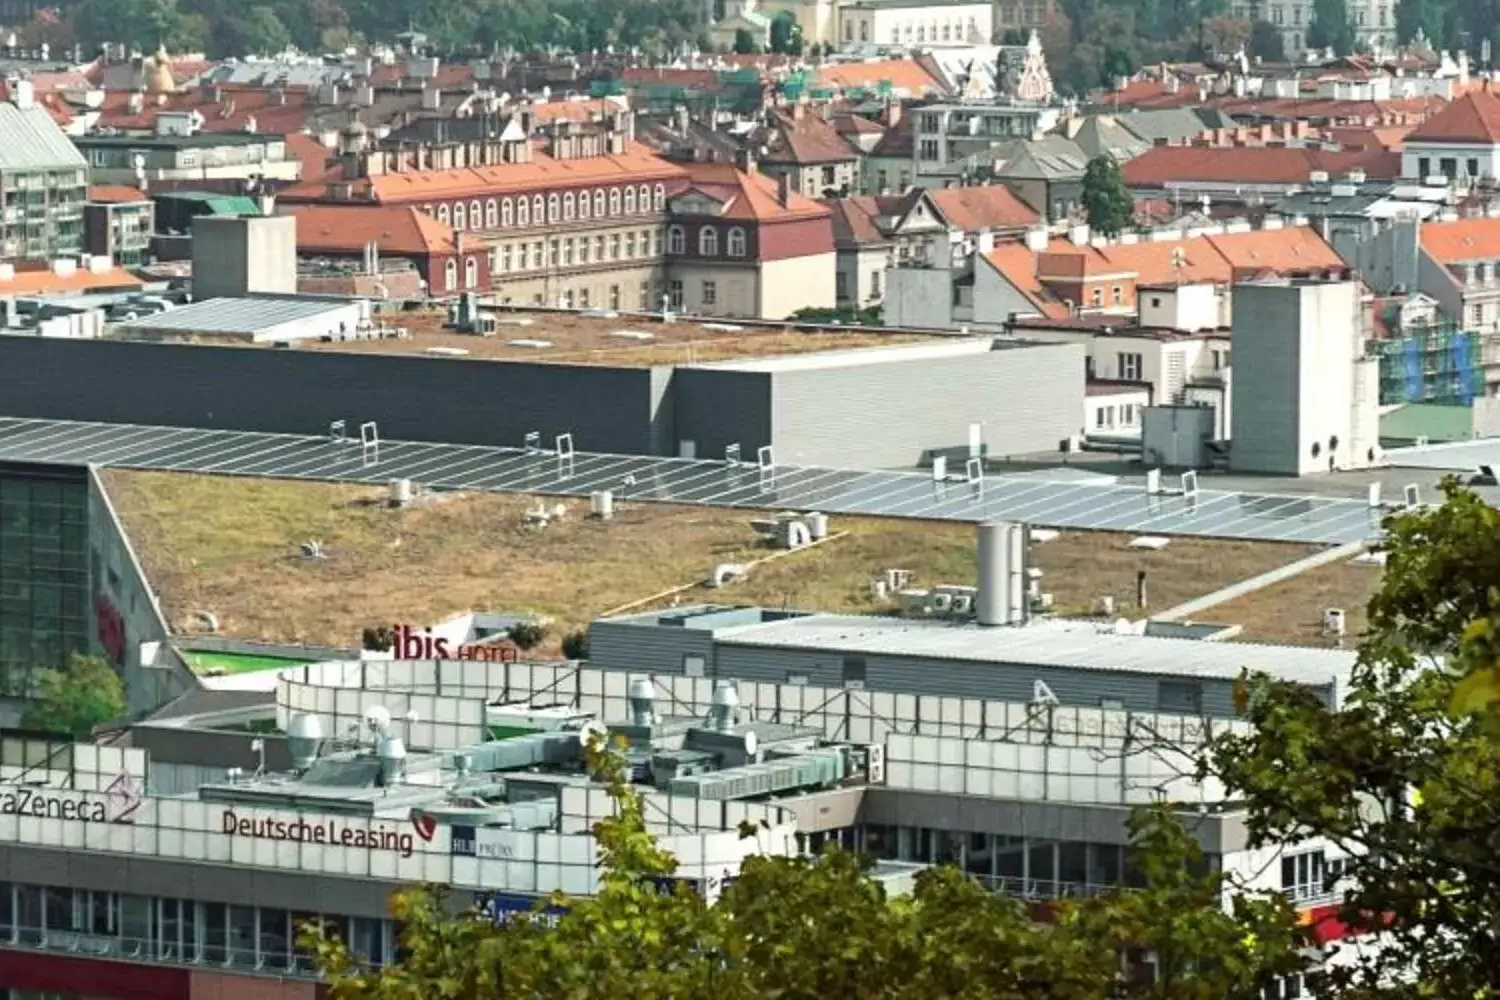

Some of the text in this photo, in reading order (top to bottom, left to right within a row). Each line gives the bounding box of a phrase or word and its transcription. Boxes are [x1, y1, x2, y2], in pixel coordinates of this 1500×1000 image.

[394, 624, 449, 660] ibis
[222, 811, 413, 858] Deutsche Leasing
